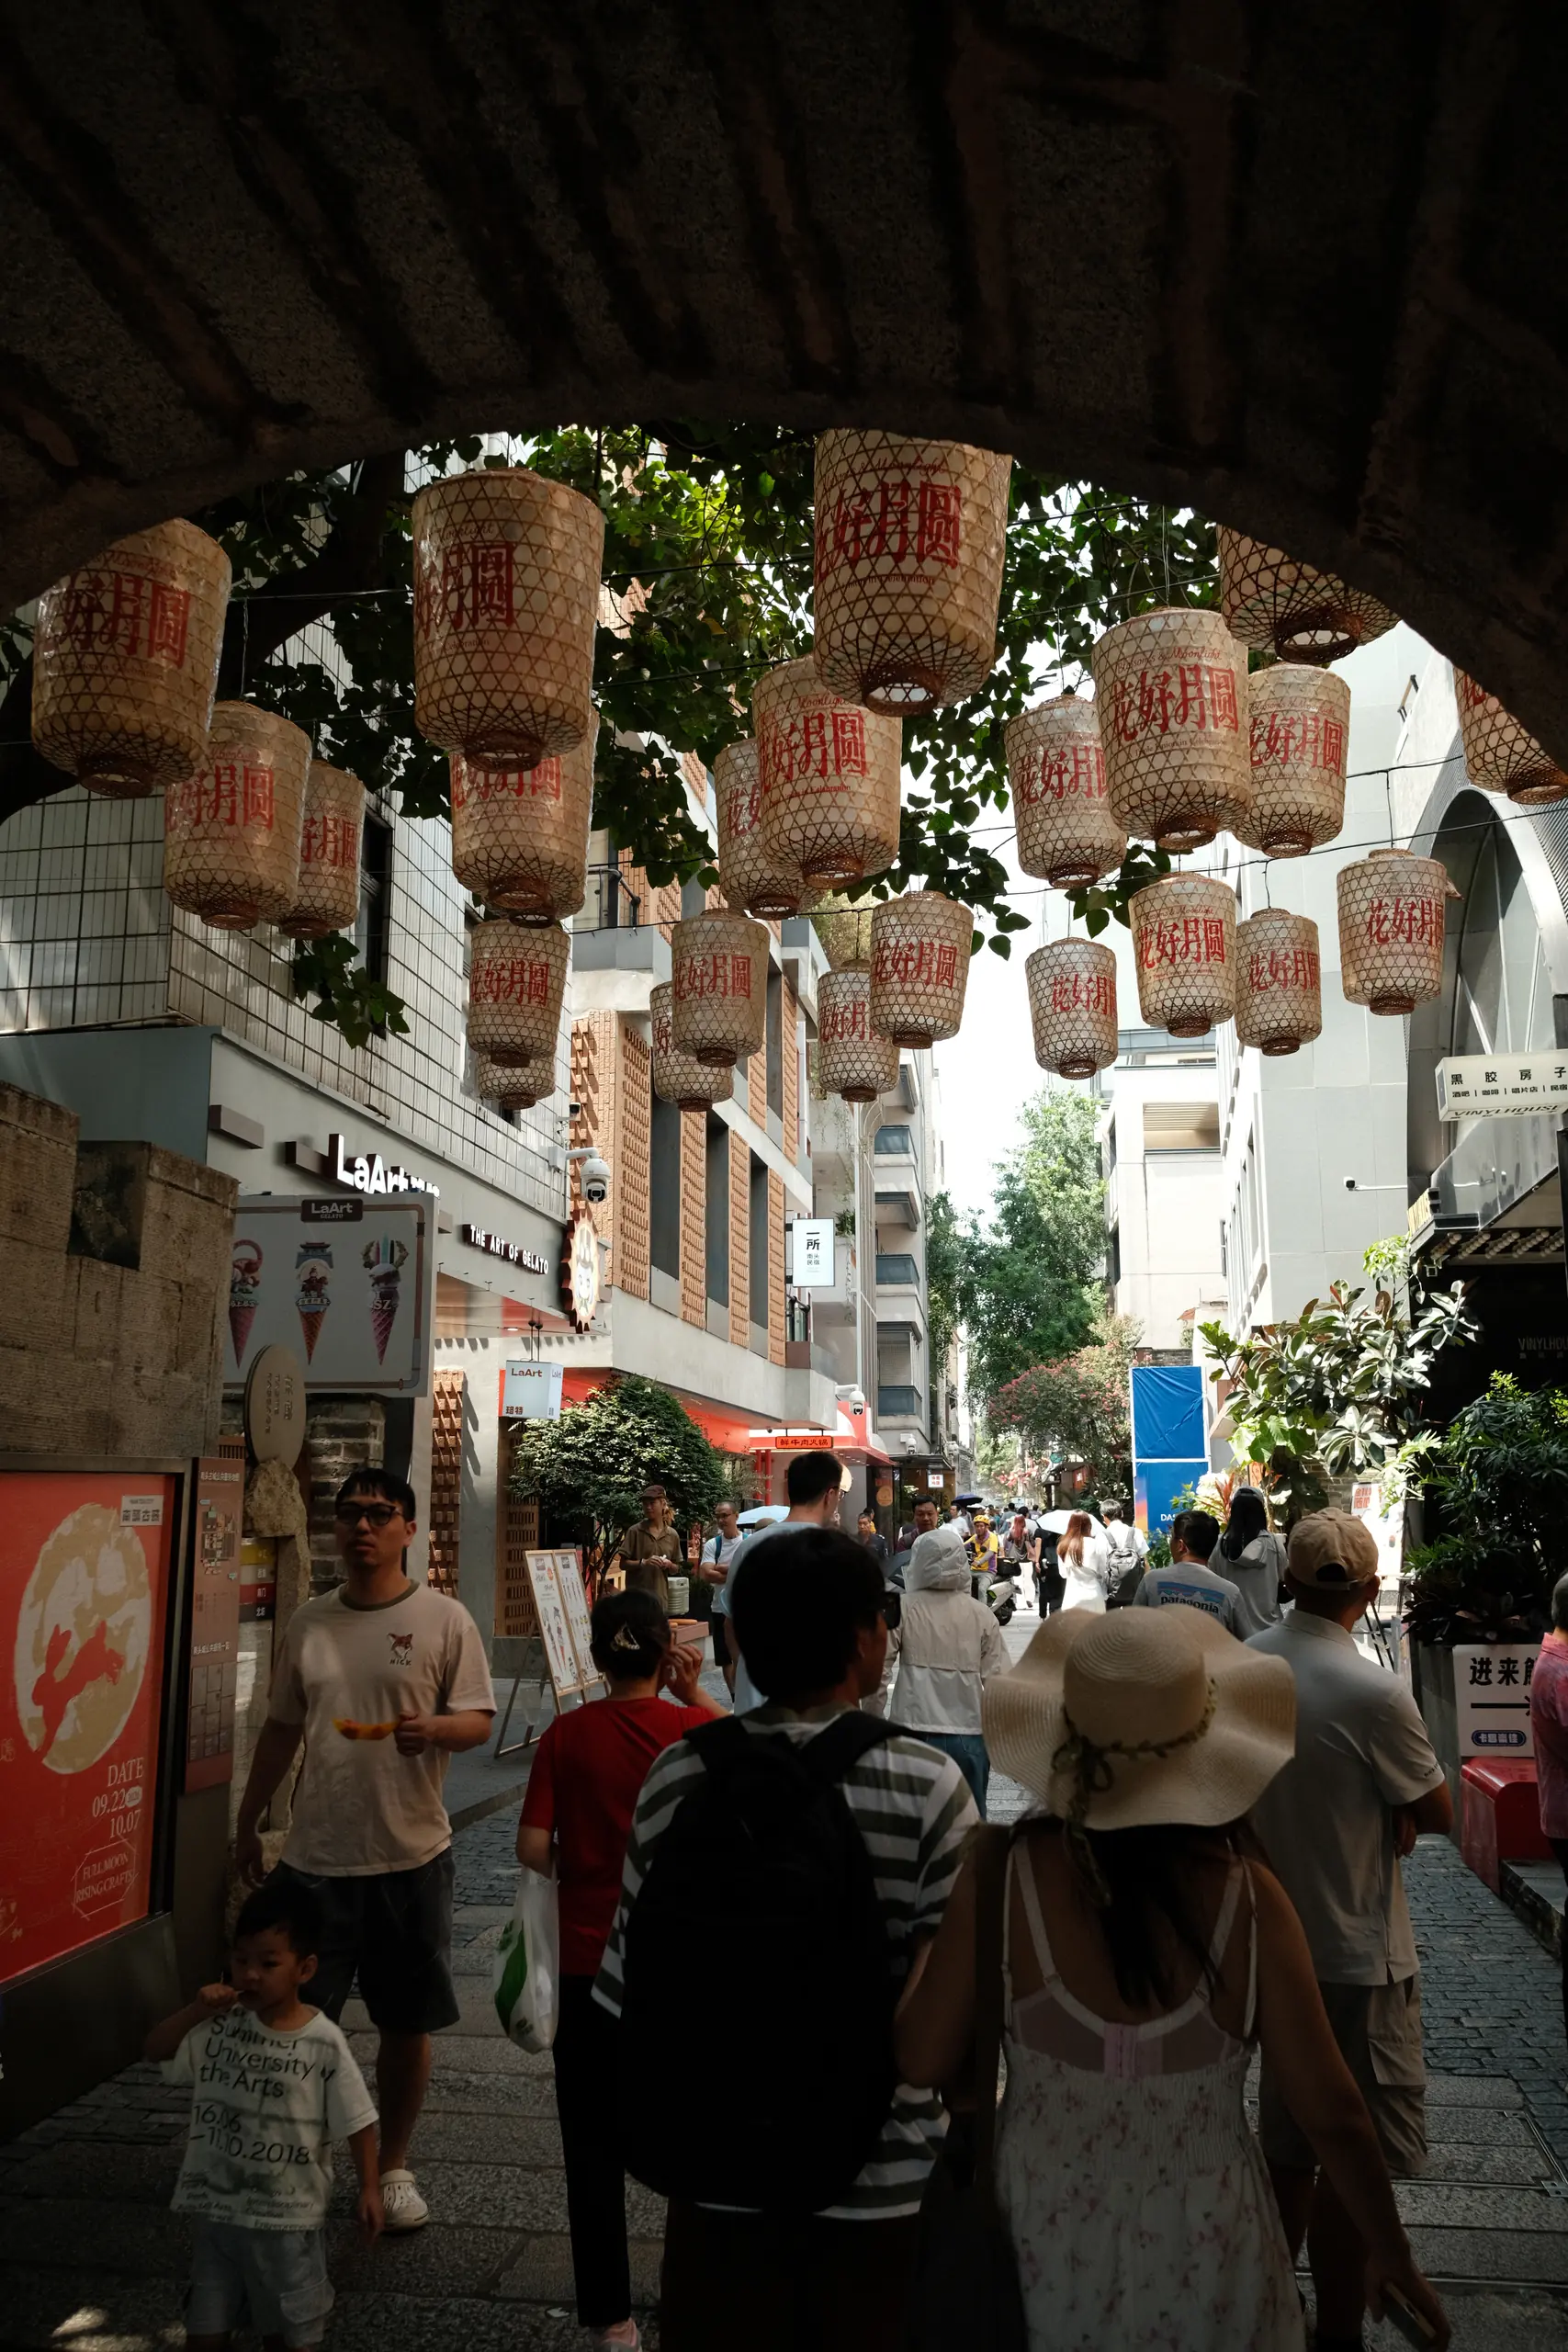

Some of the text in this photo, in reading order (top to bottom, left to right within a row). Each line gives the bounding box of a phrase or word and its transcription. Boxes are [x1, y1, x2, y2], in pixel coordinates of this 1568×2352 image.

[1168, 646, 1223, 661] Moonlight
[1113, 663, 1239, 747] 花好月圆
[1366, 898, 1445, 948] 花好月圆
[1140, 917, 1225, 969] 花好月圆
[675, 955, 750, 1001] 花好月圆
[871, 938, 958, 989] 花好月圆
[1450, 1066, 1567, 1085] 黑胶房子
[1511, 1086, 1539, 1094] 唱片店
[335, 1133, 409, 1194] LaArt
[310, 1202, 354, 1214] LaArt
[469, 1224, 549, 1275] THE ART OF GELATO
[806, 1231, 820, 1250] 一所
[512, 1367, 543, 1378] LaArt
[780, 1438, 829, 1447] 鲜牛肉火锅
[1160, 1595, 1219, 1614] patagonia
[107, 1757, 144, 1787] DATE
[92, 1787, 126, 1817] 09.22
[110, 1808, 141, 1838] 10.07
[104, 1851, 129, 1872] MOON
[76, 1869, 134, 1904] RISING CRAFTS
[206, 2036, 316, 2081] University
[231, 2069, 284, 2098] Arts
